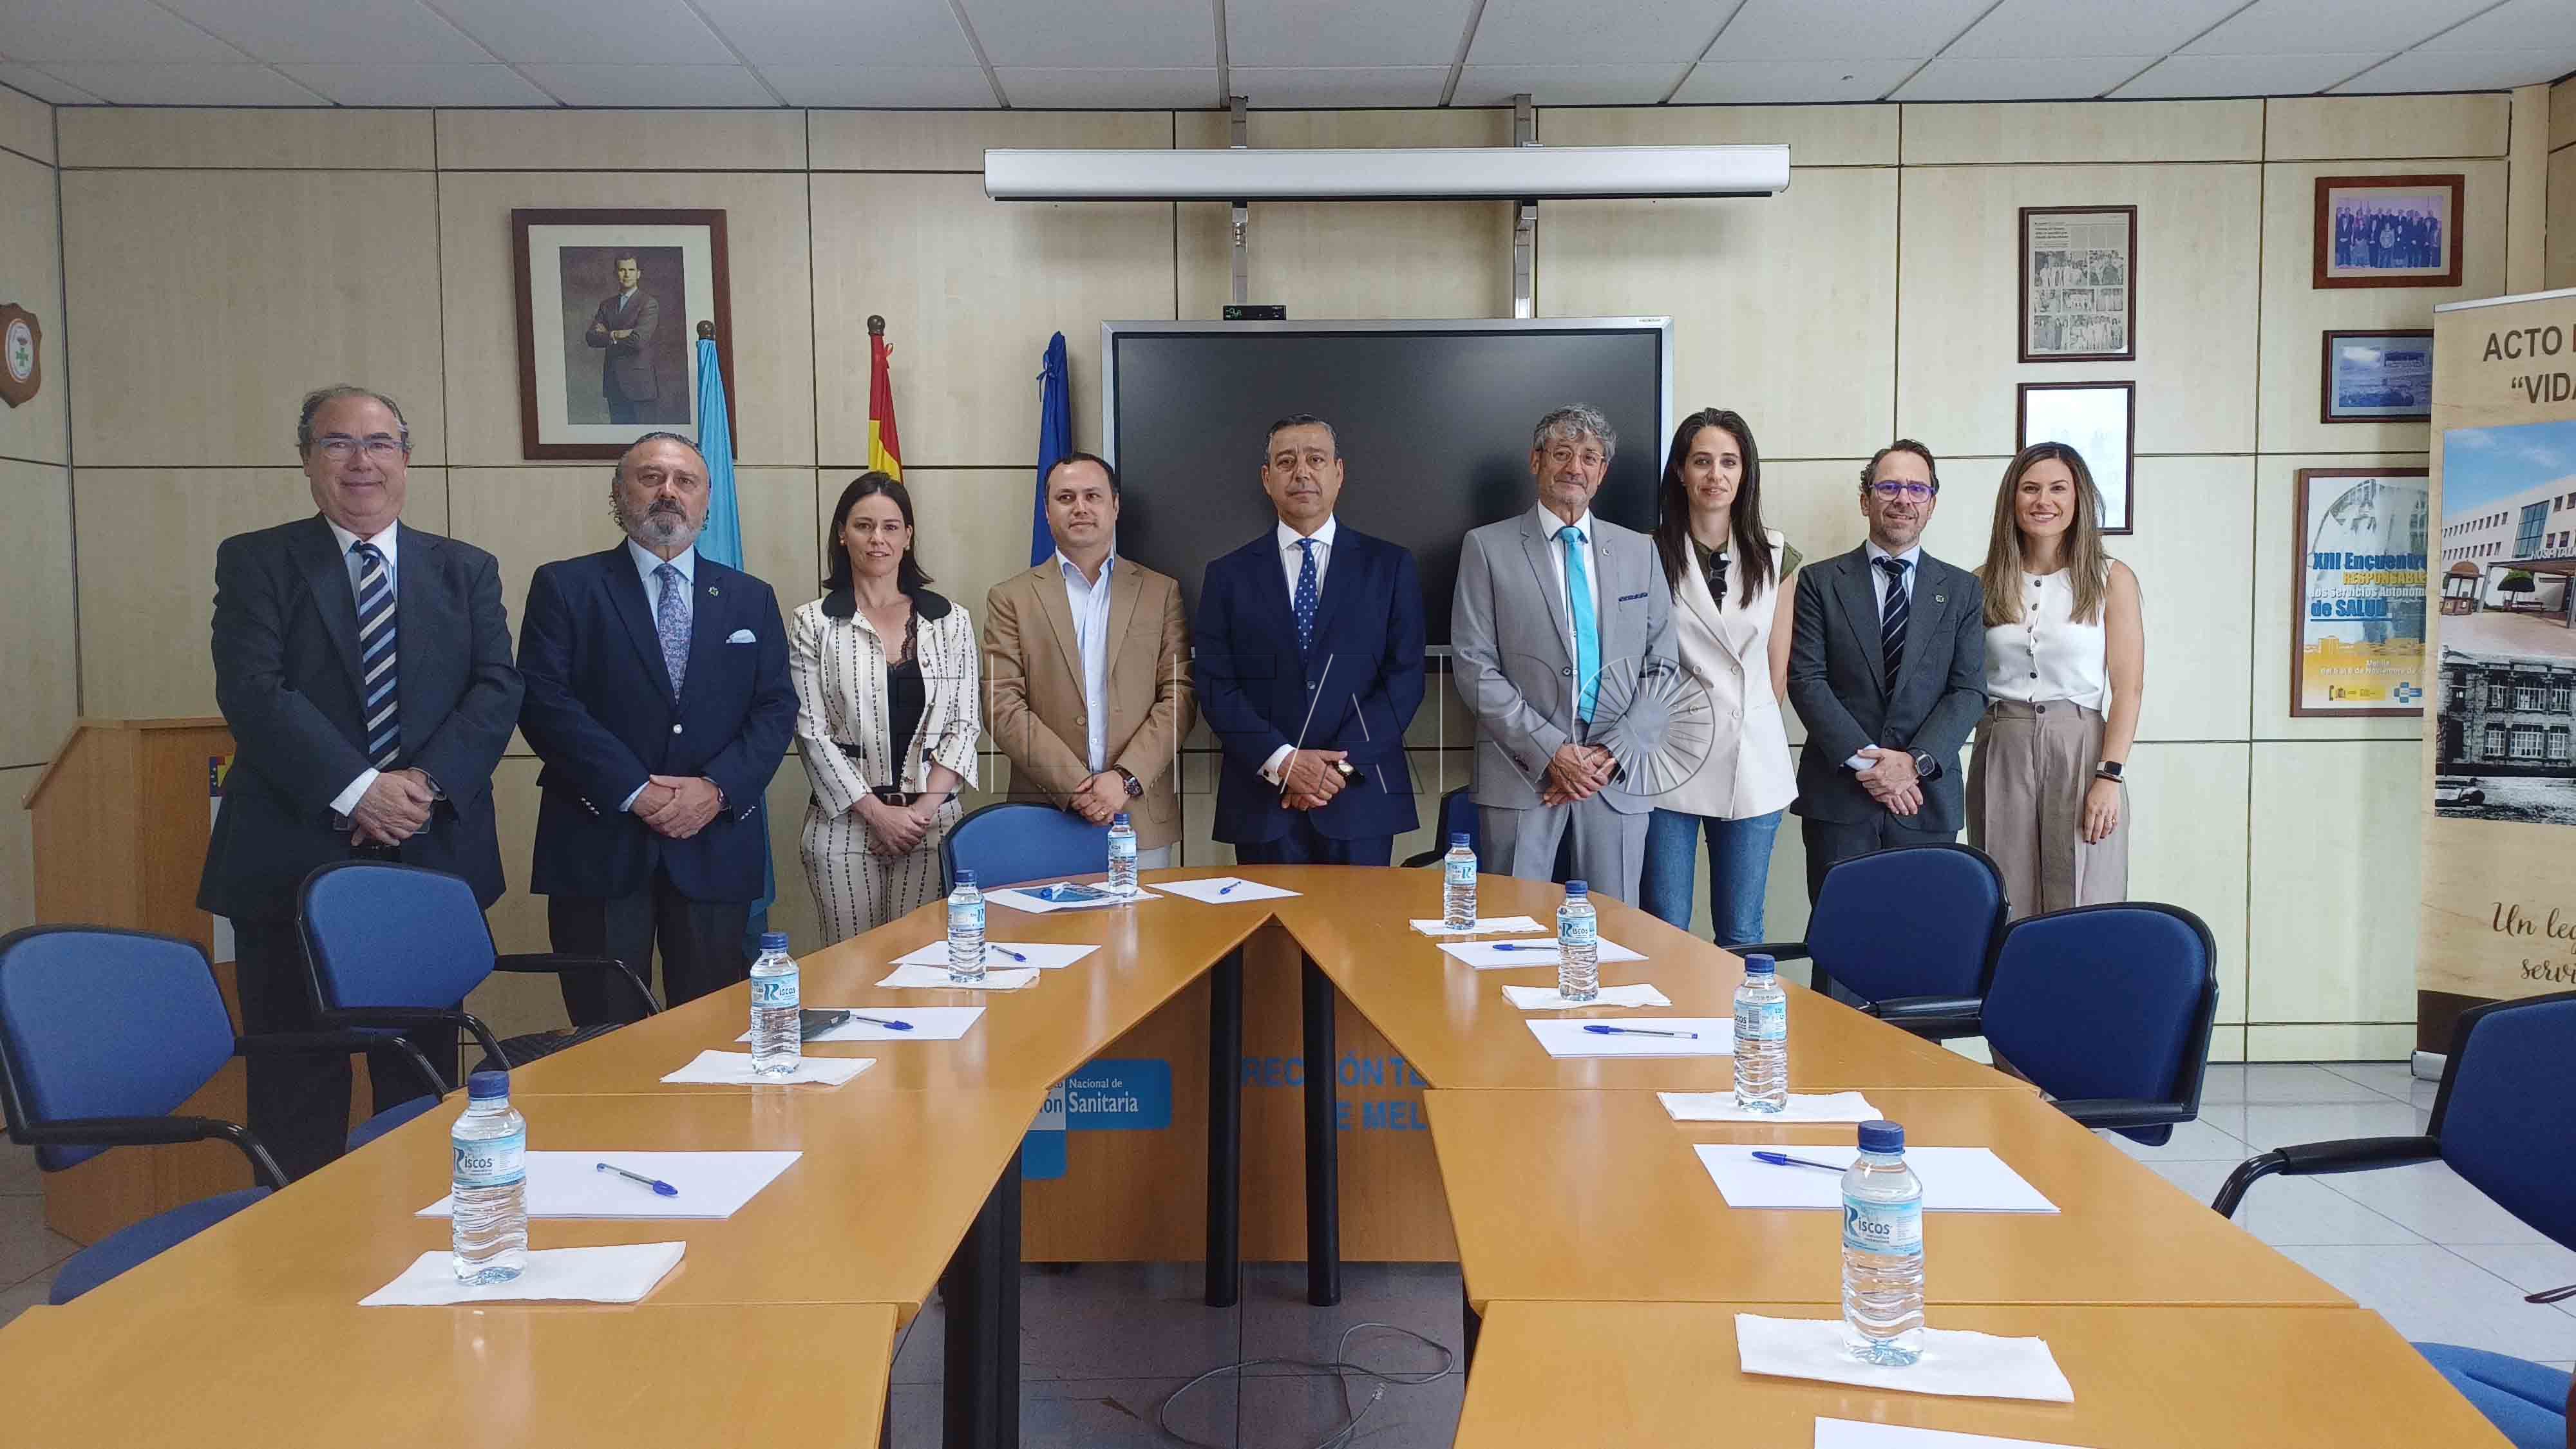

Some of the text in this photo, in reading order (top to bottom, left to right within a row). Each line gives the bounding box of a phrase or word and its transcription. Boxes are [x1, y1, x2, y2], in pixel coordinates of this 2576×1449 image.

[2483, 325, 2562, 362] ACTO
[2313, 552, 2342, 570] XIII
[2311, 598, 2389, 617] de SALUD
[2492, 902, 2537, 937] Un
[1068, 1078, 1109, 1089] Nacional
[1111, 1078, 1123, 1088] de
[1068, 1091, 1139, 1113] Sanitaria
[453, 1146, 494, 1174] Riscos
[1843, 1203, 1891, 1237] Riscos
